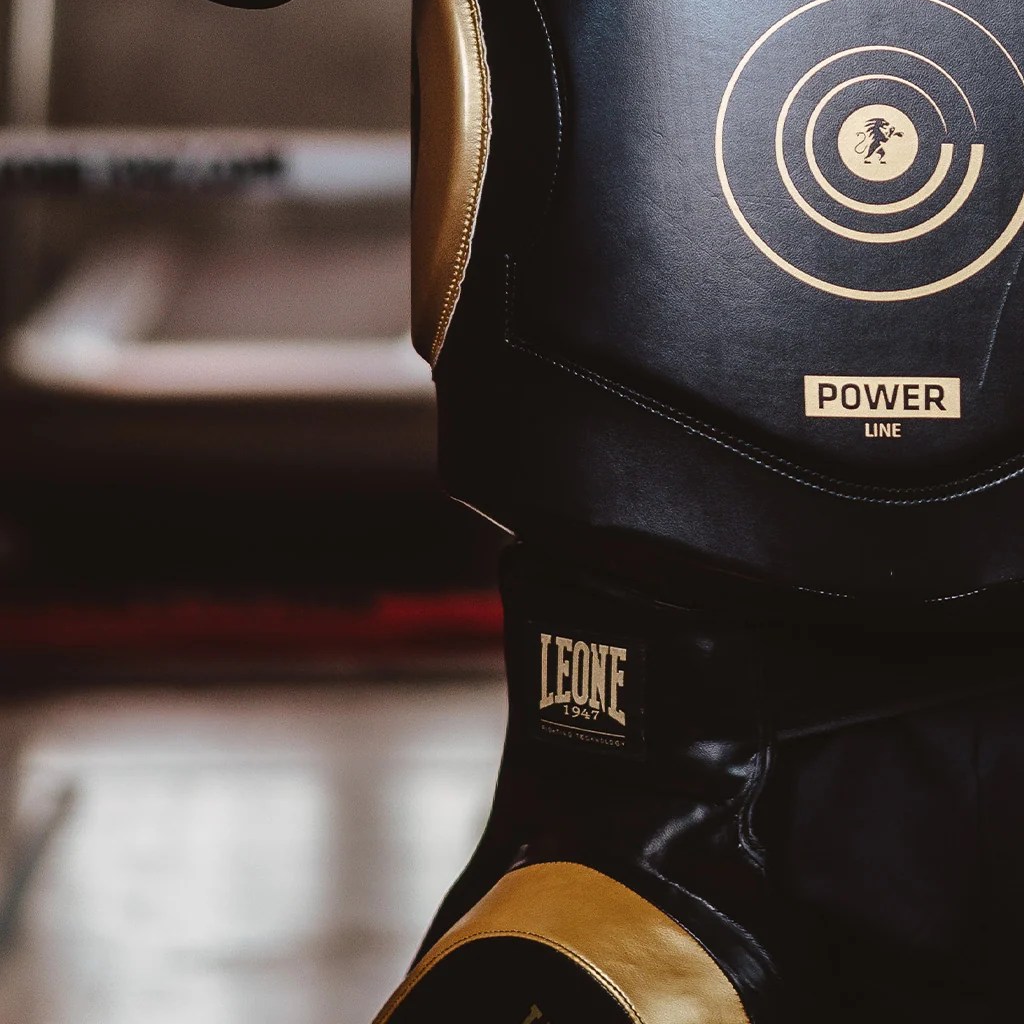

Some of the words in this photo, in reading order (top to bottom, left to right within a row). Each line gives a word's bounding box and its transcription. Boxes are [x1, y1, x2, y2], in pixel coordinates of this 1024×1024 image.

[818, 382, 947, 411] POWER
[864, 422, 902, 438] LINE
[539, 632, 627, 727] LEONE
[563, 704, 600, 720] 1947
